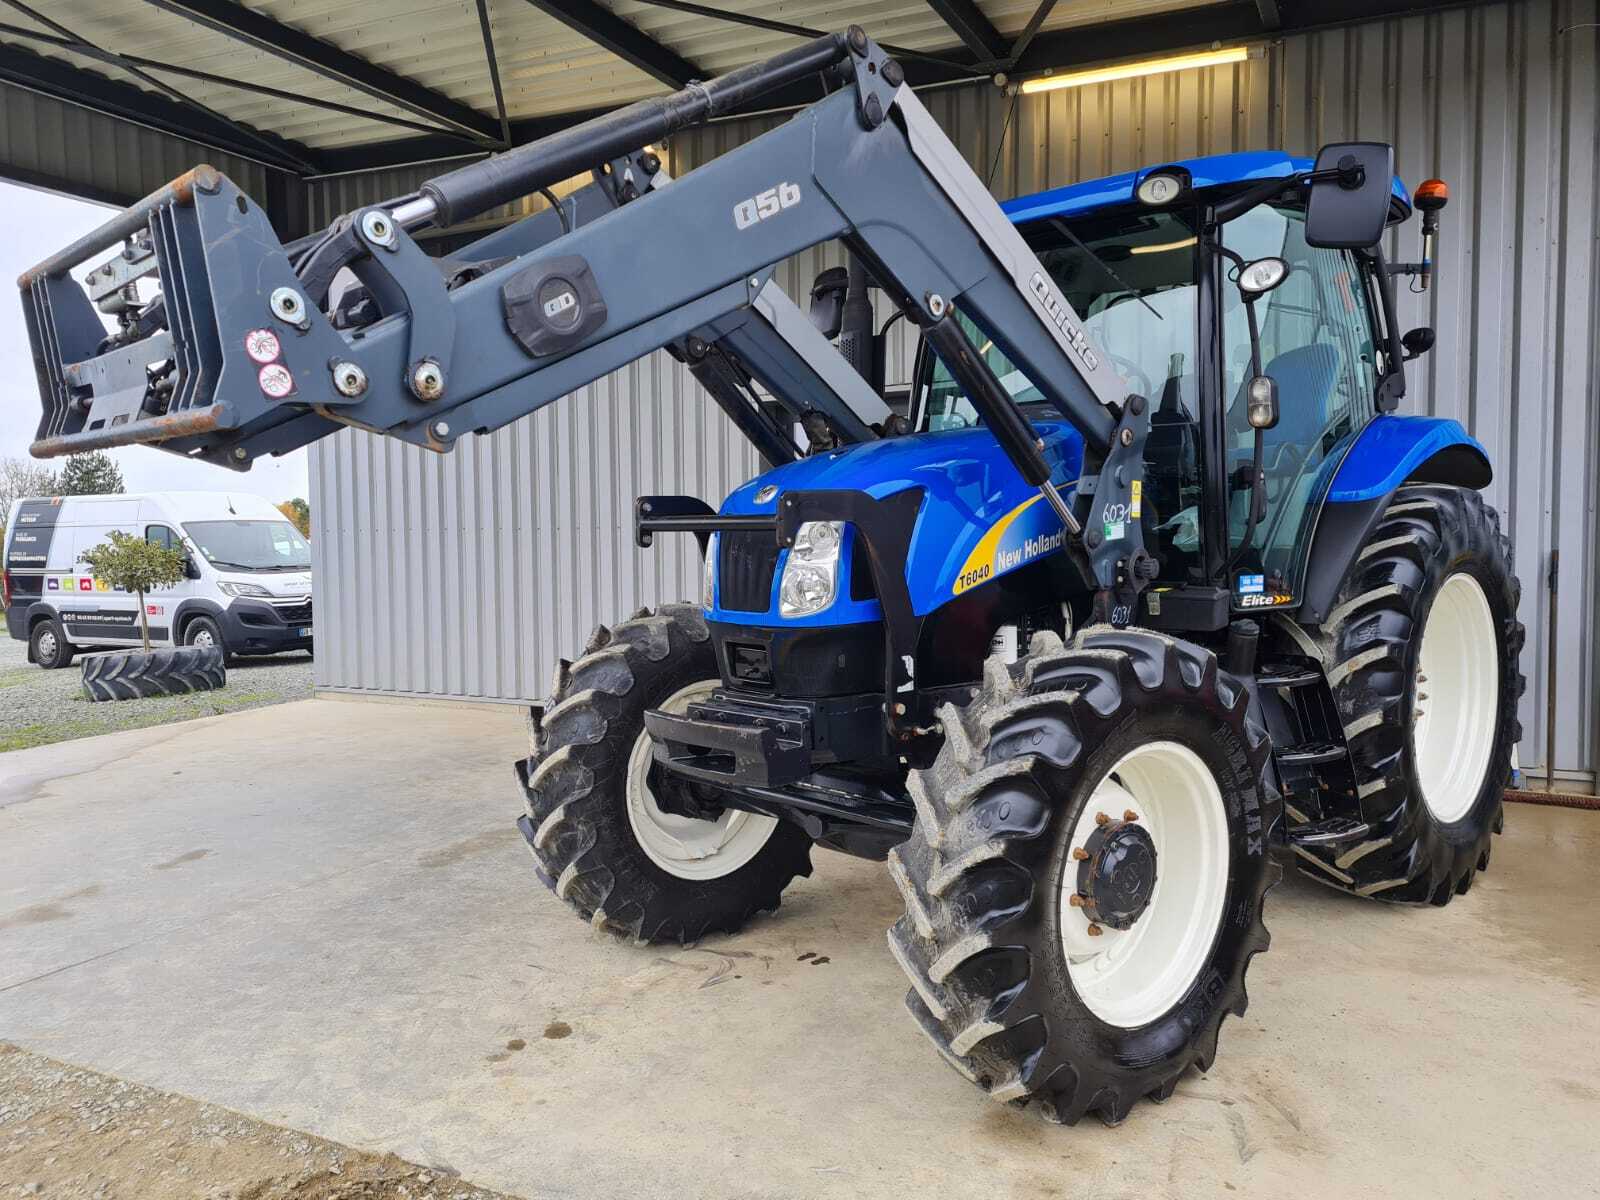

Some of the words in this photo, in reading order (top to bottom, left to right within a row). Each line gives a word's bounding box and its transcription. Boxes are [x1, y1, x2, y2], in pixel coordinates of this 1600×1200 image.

[1102, 503, 1132, 524] 6031
[997, 548, 1022, 573] New
[1024, 527, 1062, 560] Holland
[959, 564, 990, 590] T6040
[1241, 594, 1274, 607] Elite
